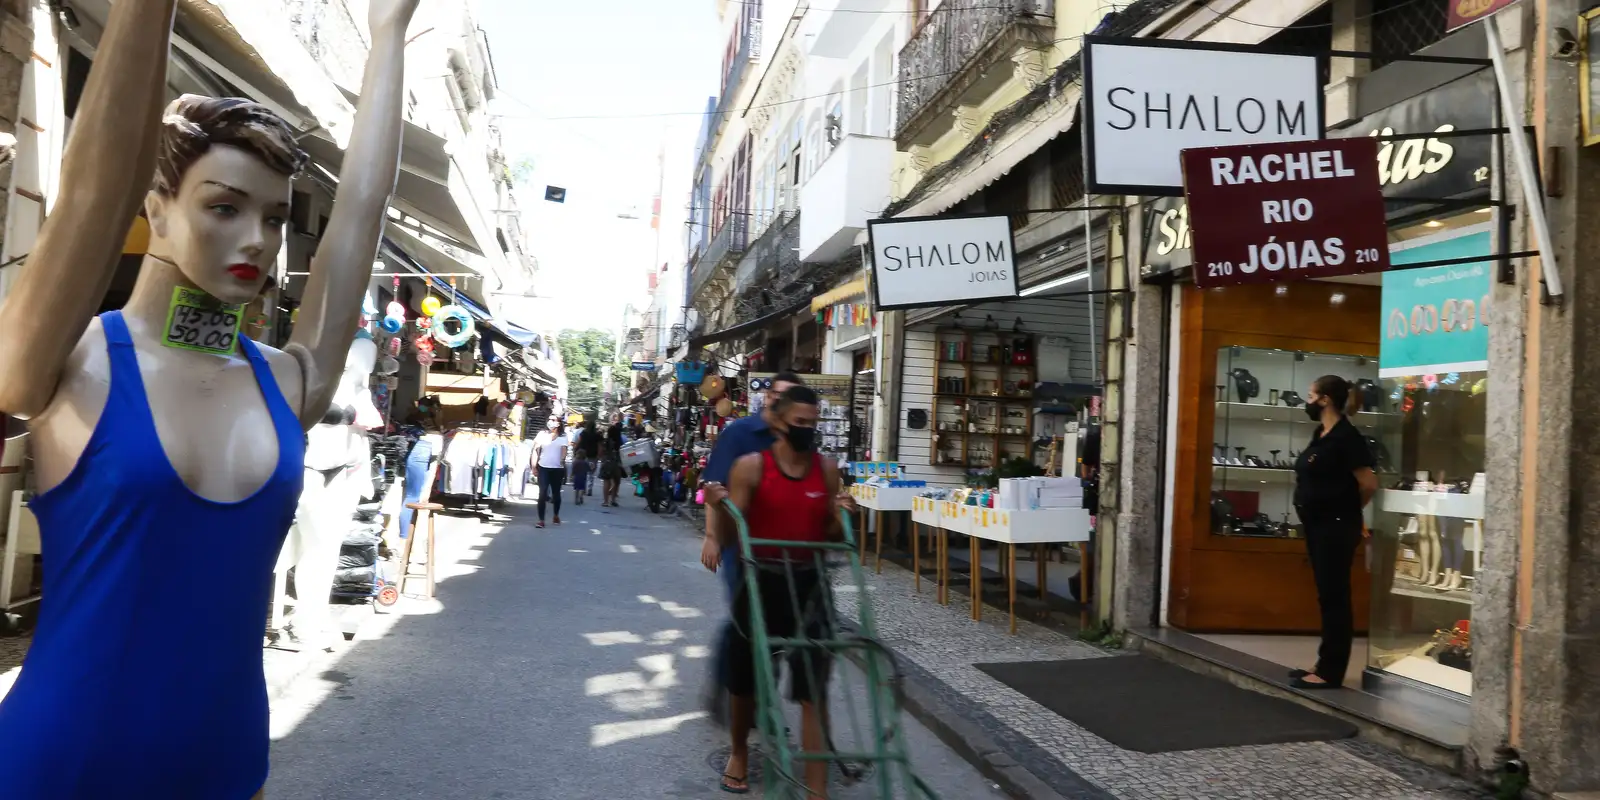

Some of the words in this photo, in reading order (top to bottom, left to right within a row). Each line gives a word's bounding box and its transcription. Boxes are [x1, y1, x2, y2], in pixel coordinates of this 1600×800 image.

[1106, 86, 1307, 136] SHALOM
[1210, 149, 1356, 186] RACHEL
[1371, 124, 1455, 186] ias
[1157, 203, 1192, 256] Sh
[1261, 197, 1314, 224] RIO
[883, 240, 1006, 272] SHALOM
[1207, 261, 1233, 277] 210
[1239, 235, 1346, 274] JÓIAS
[1355, 248, 1380, 264] 210
[968, 269, 1009, 283] JOIAS
